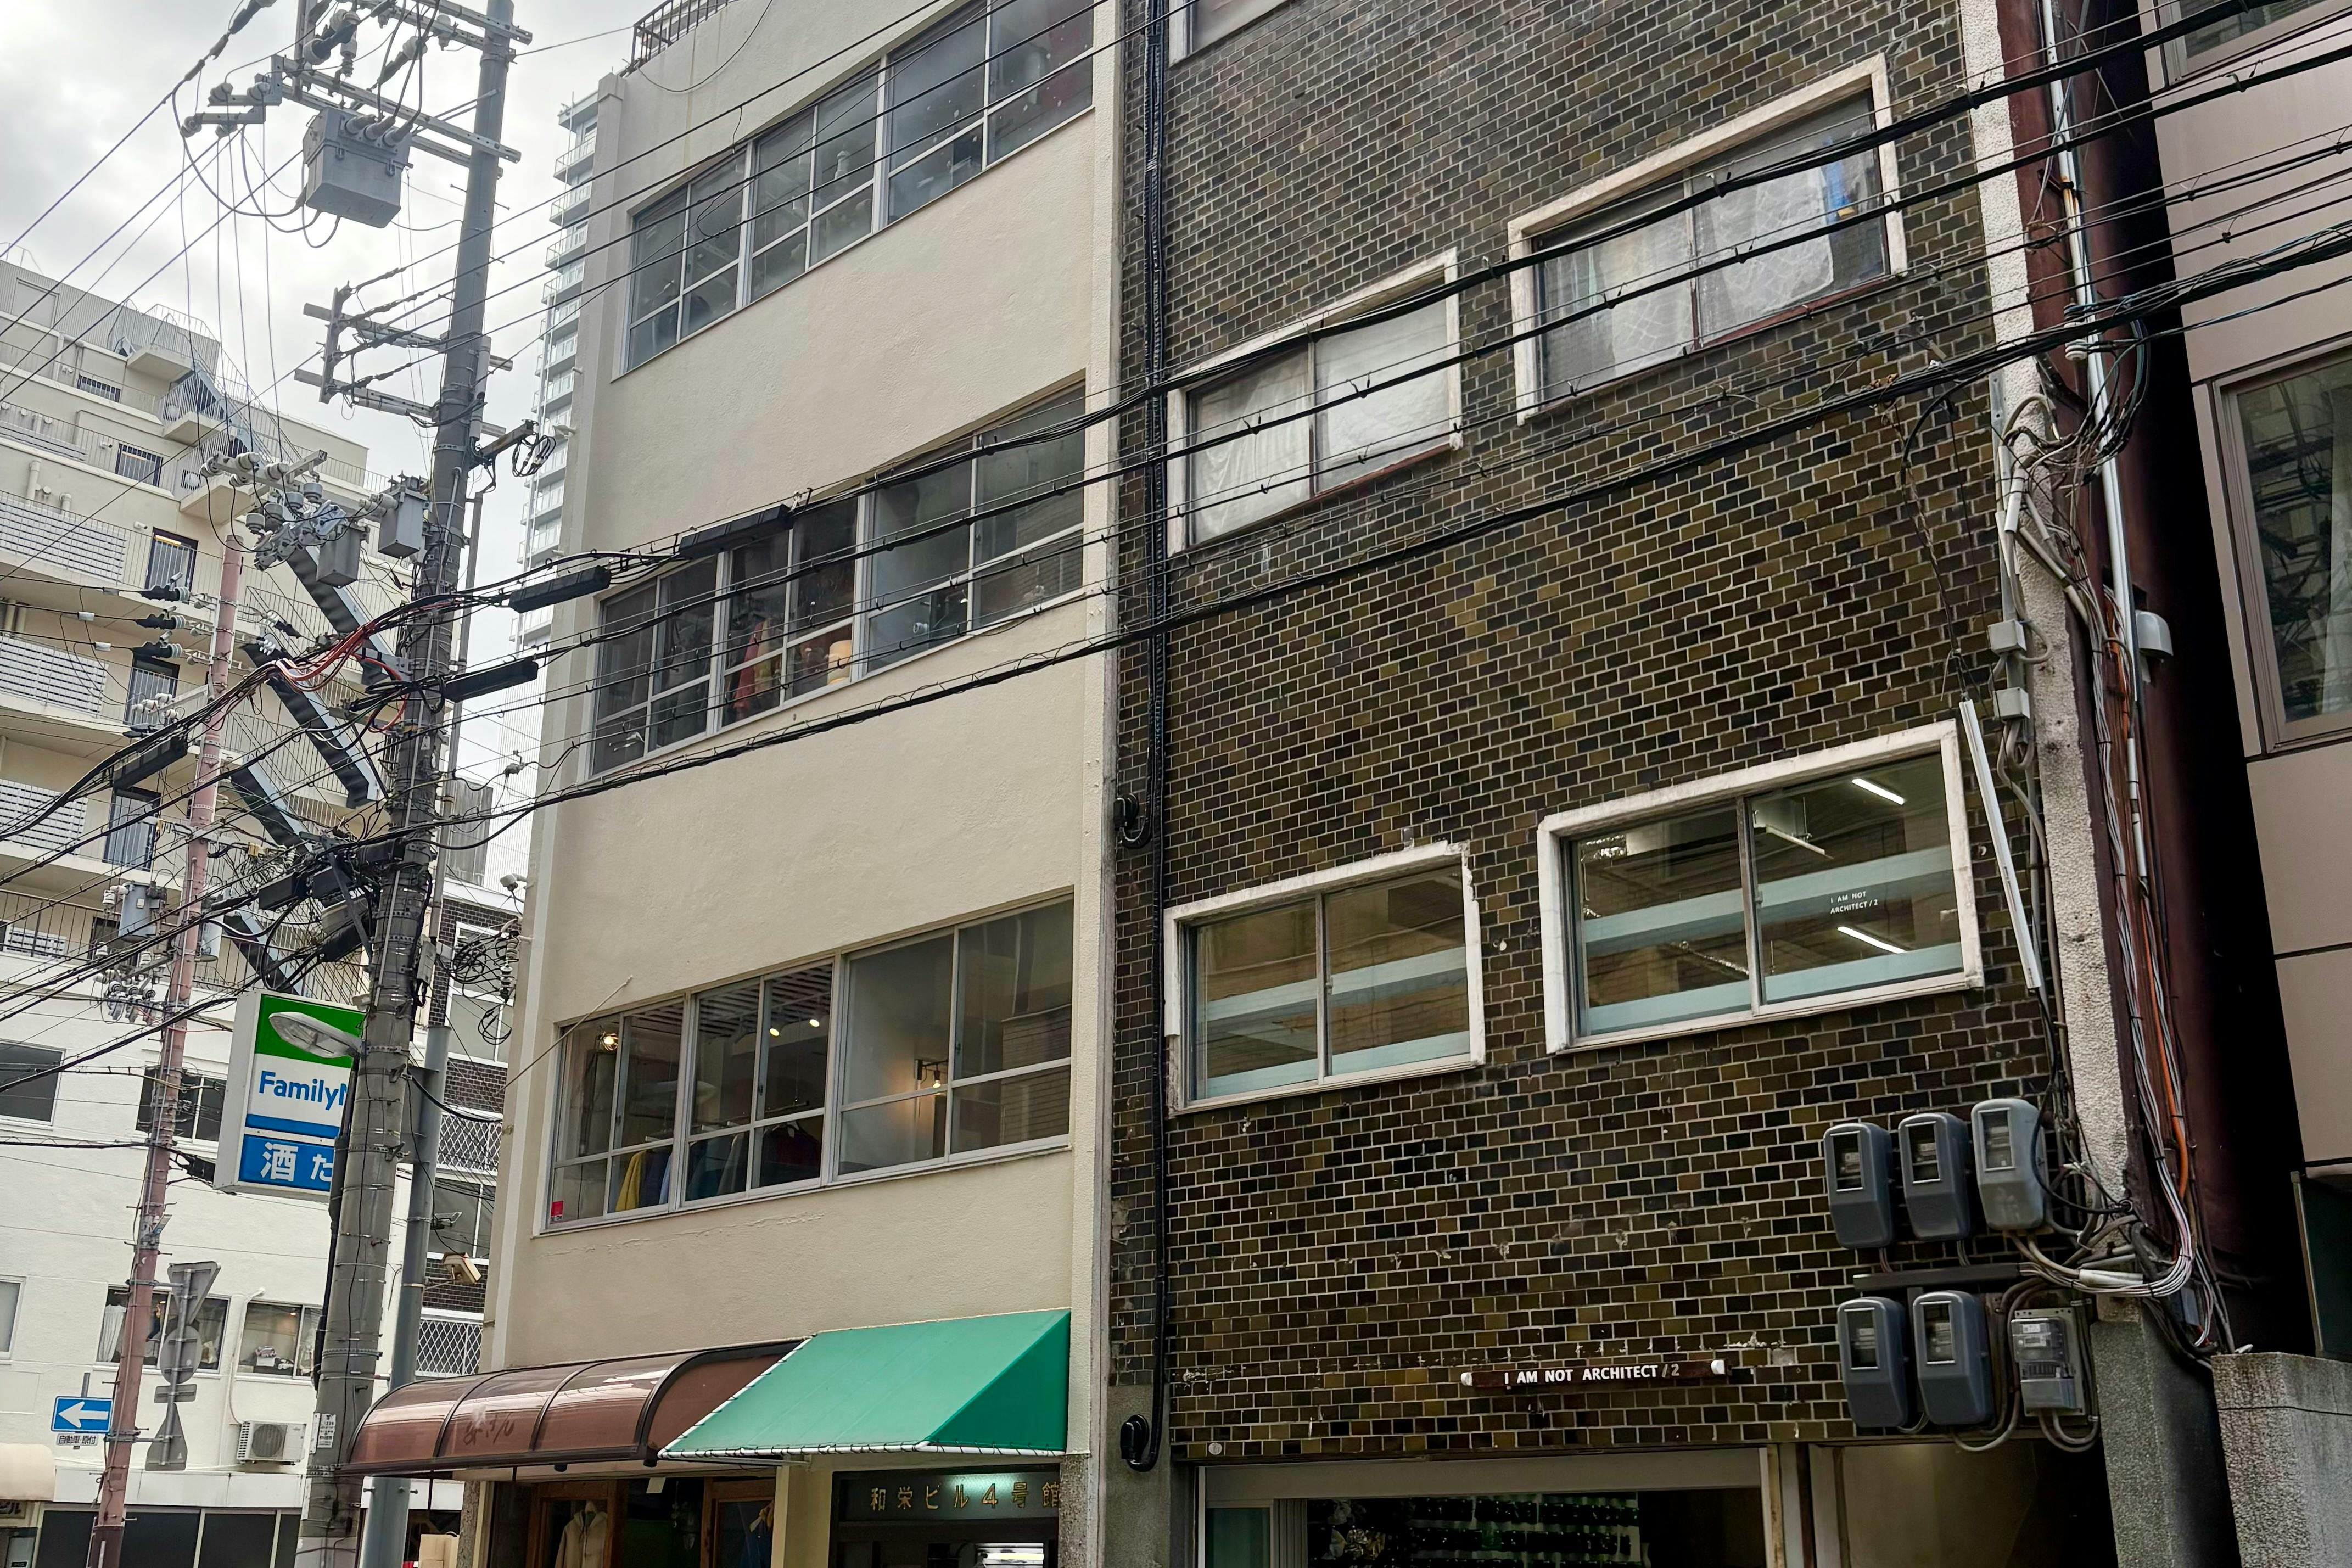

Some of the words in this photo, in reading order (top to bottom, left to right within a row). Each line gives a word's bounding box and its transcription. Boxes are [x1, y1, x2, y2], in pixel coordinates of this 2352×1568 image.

[1838, 894, 1848, 903] AM
[1852, 891, 1866, 899] NOT
[1830, 901, 1867, 914] ARCHITECT
[1504, 1372, 1509, 1384] I
[1516, 1370, 1538, 1384] AM
[1544, 1369, 1573, 1382] NOT
[1582, 1365, 1658, 1381] ARCHITECT
